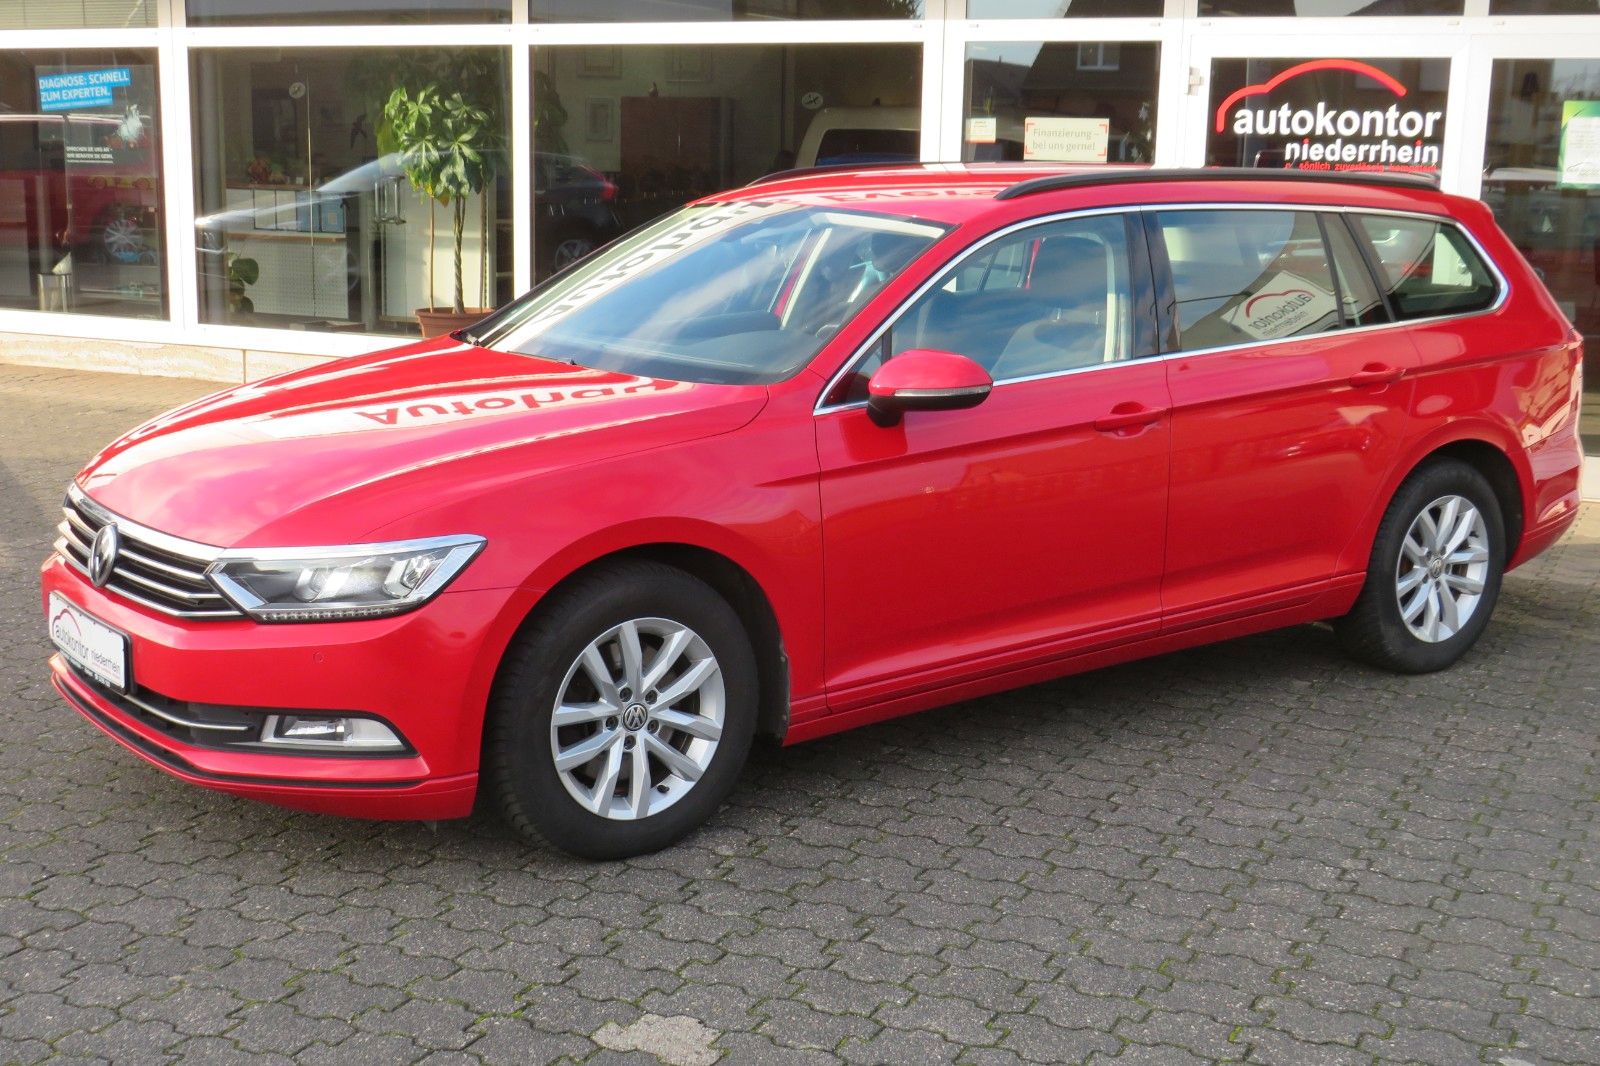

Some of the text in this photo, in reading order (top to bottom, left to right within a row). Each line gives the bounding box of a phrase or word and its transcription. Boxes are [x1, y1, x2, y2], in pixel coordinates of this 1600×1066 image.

[39, 71, 129, 89] DIAGNOSE: SCHNELL
[41, 86, 111, 101] ZUM EXPERTEN.
[1233, 102, 1442, 137] autokontor
[1033, 128, 1092, 139] Finanzierung
[1033, 141, 1046, 150] bei
[1285, 138, 1440, 163] niederrhein
